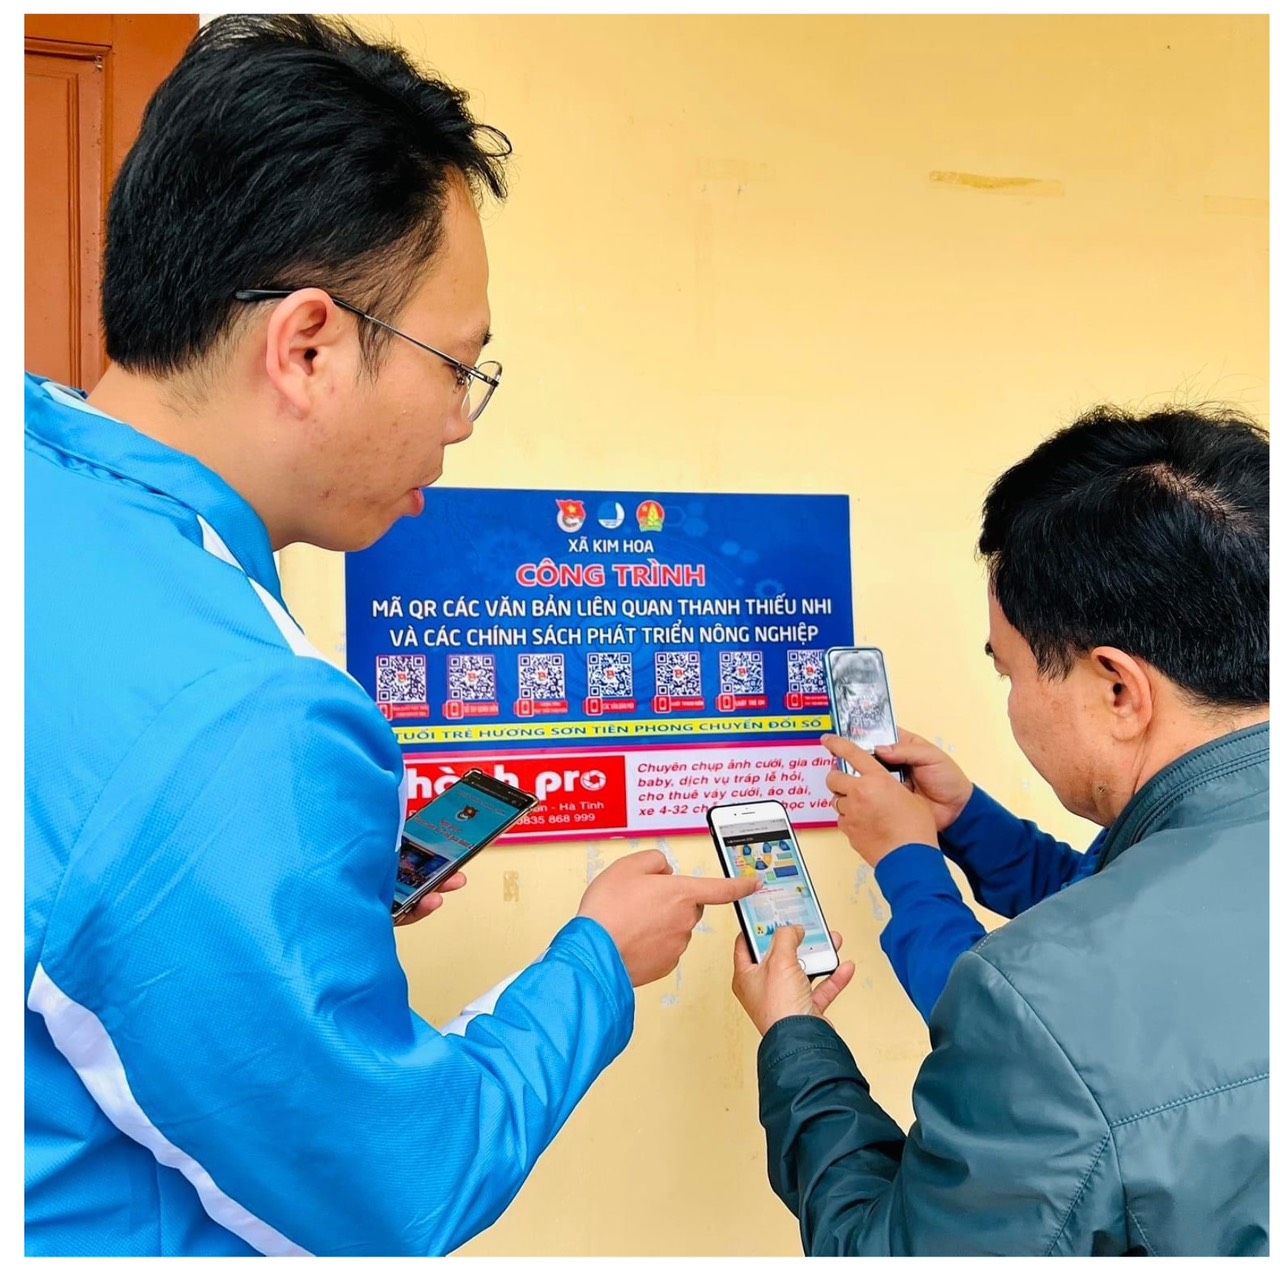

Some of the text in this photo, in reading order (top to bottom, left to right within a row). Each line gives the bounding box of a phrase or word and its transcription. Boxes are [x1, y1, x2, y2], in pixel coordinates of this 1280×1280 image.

[567, 535, 654, 554] XÃ KIM HOA
[515, 557, 706, 587] CÔNG TRÌNH
[372, 591, 832, 621] MÃ QR CÁC VĂN BẢN LIÊN QUAN THANH THIẾU NHI
[389, 619, 818, 647] VÀ CÁC CHÍNH SÁCH PHÁT TRIỂN NÔNG NGHIỆP
[479, 728, 545, 737] HƯƠNG
[551, 726, 586, 735] SƠN
[592, 725, 628, 734] TIÊN
[635, 723, 693, 733] PHONG
[638, 761, 687, 775] Chuyên
[692, 761, 724, 772] chụp
[728, 758, 751, 769] ảnh
[788, 758, 807, 772] gia
[536, 768, 607, 801] pro
[679, 775, 709, 786] dịch
[714, 776, 730, 786] vụ
[734, 773, 761, 785] tráp
[638, 791, 664, 802] cho
[669, 789, 699, 799] thuê
[703, 789, 727, 800] váy
[768, 786, 783, 796] áo
[559, 801, 604, 811] Hà Tĩnh
[639, 807, 655, 816] xe
[659, 804, 688, 814] 4-32
[549, 815, 570, 824] 868
[574, 814, 596, 822] 999
